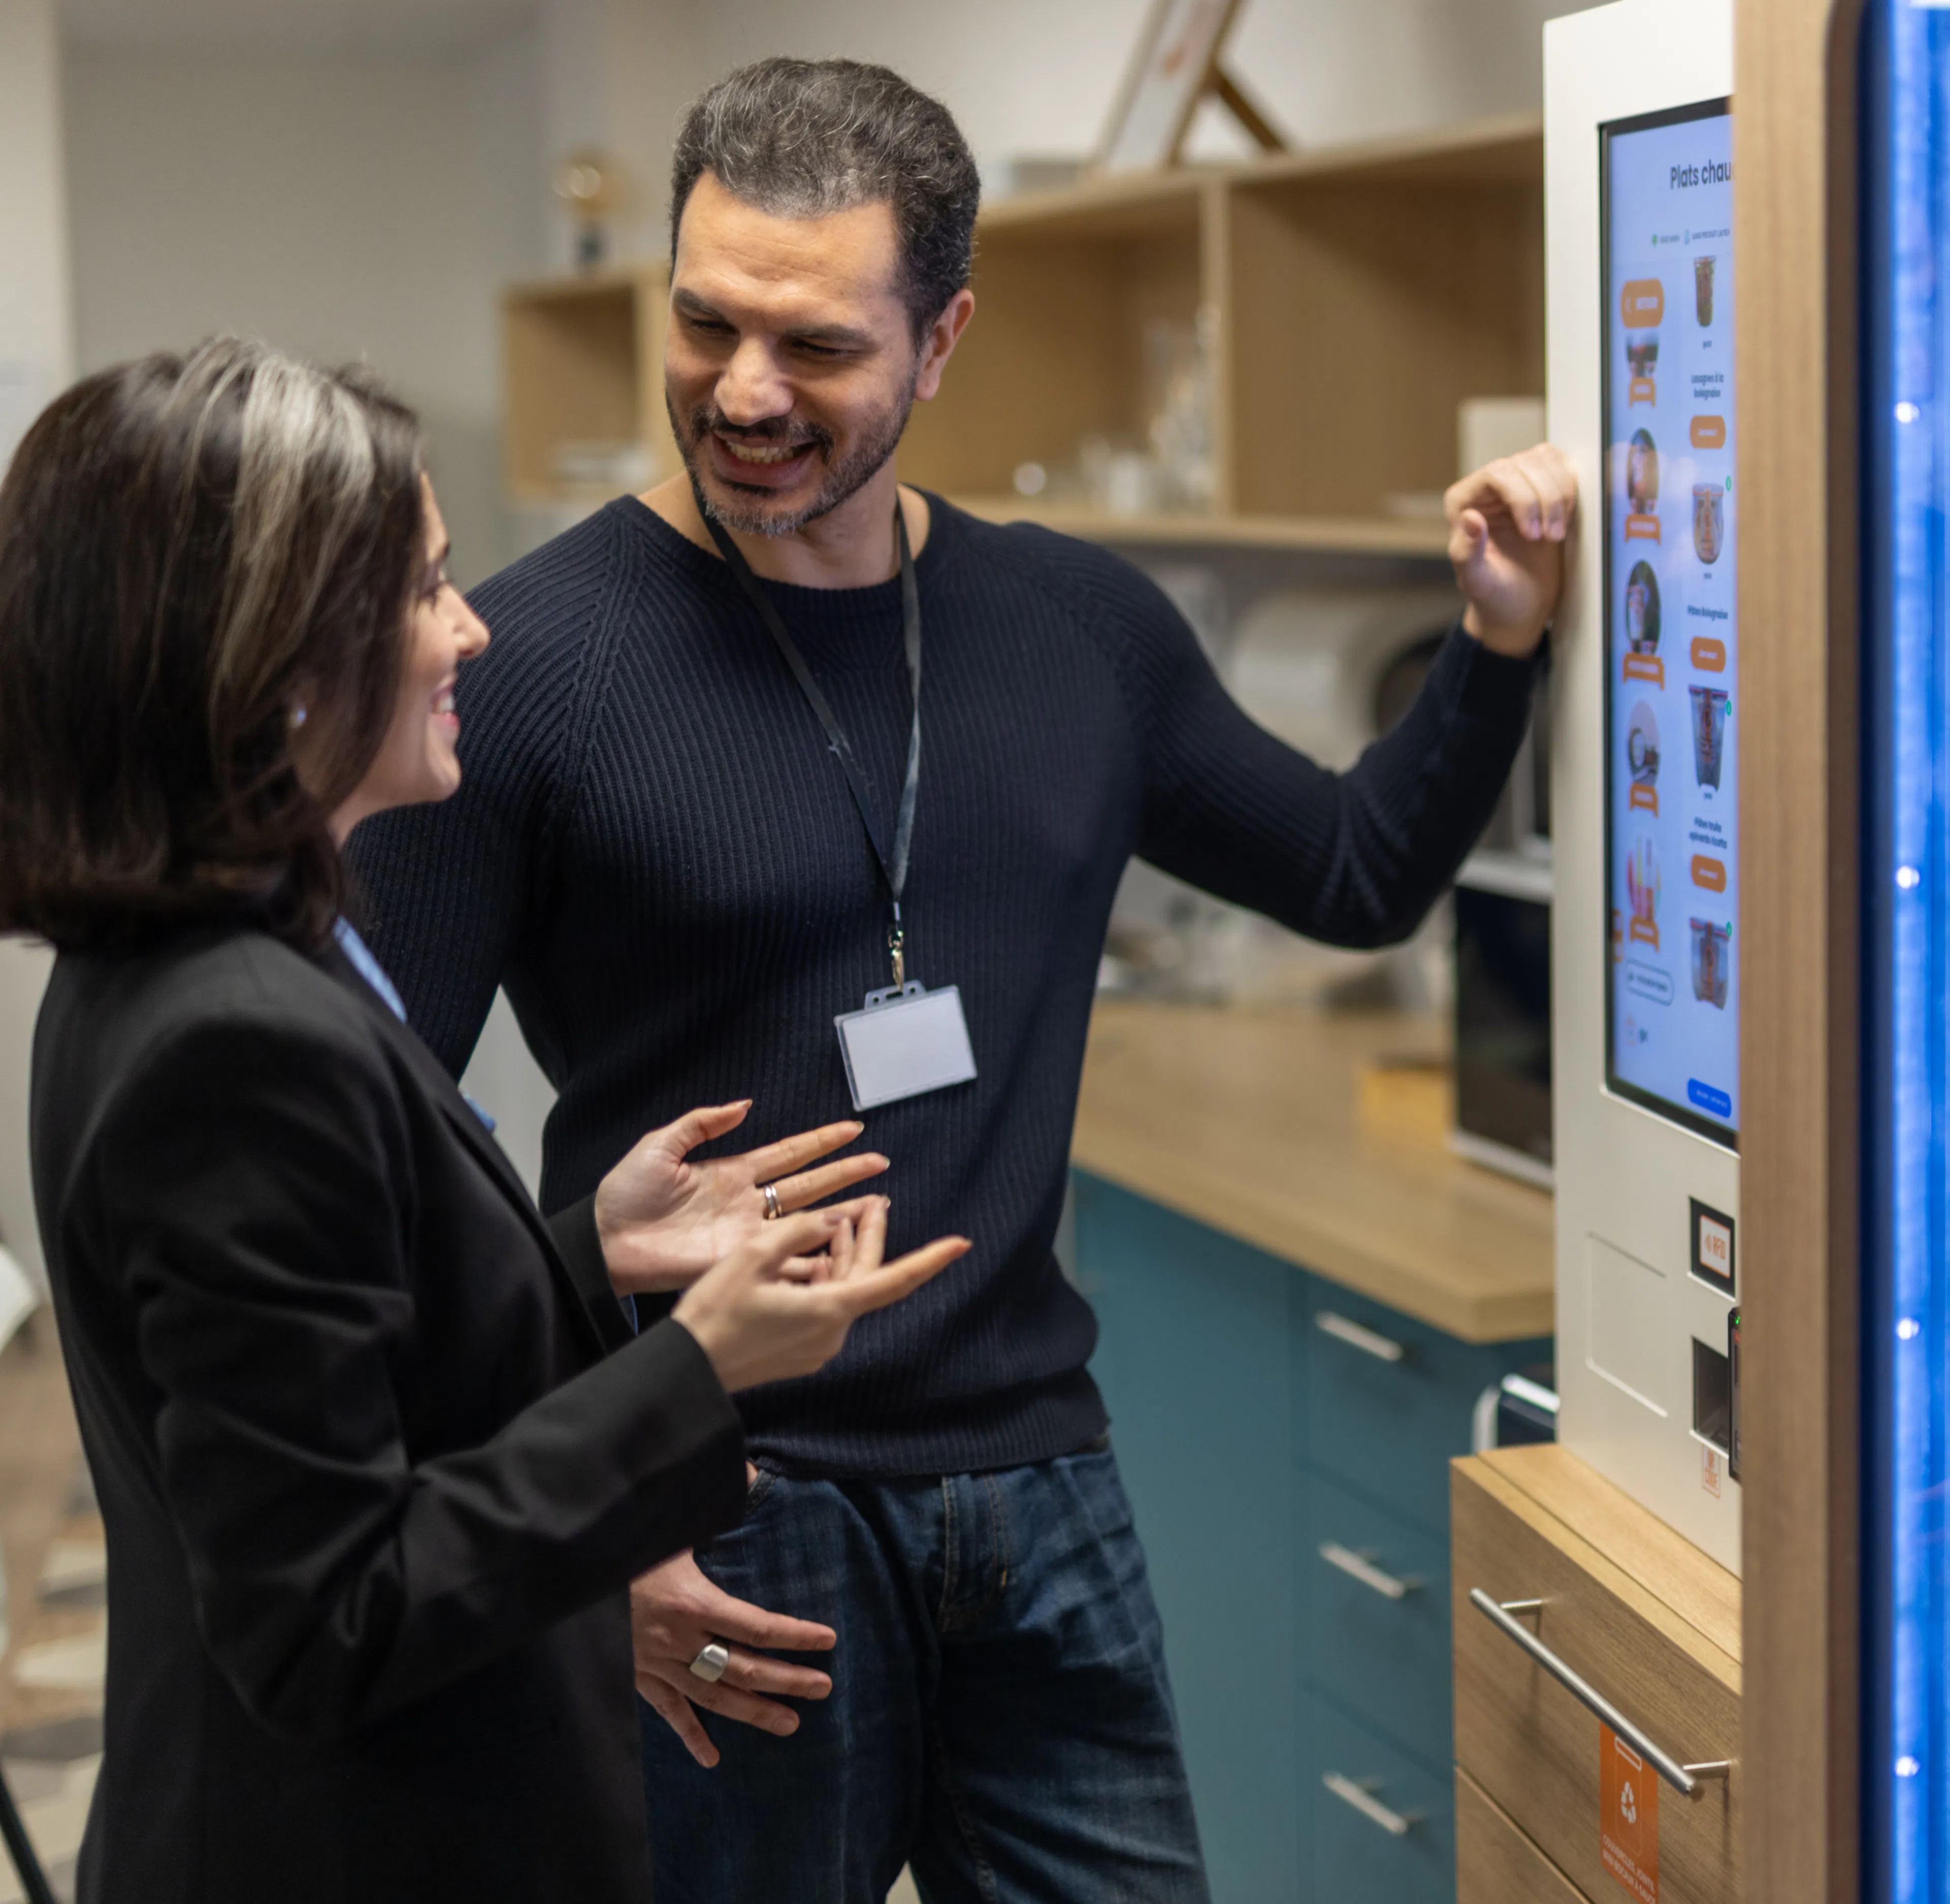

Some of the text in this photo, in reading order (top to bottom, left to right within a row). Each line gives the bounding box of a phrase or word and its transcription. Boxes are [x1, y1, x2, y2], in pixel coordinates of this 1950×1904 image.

[1670, 158, 1732, 189] Plats chau
[1719, 372, 1724, 382] la
